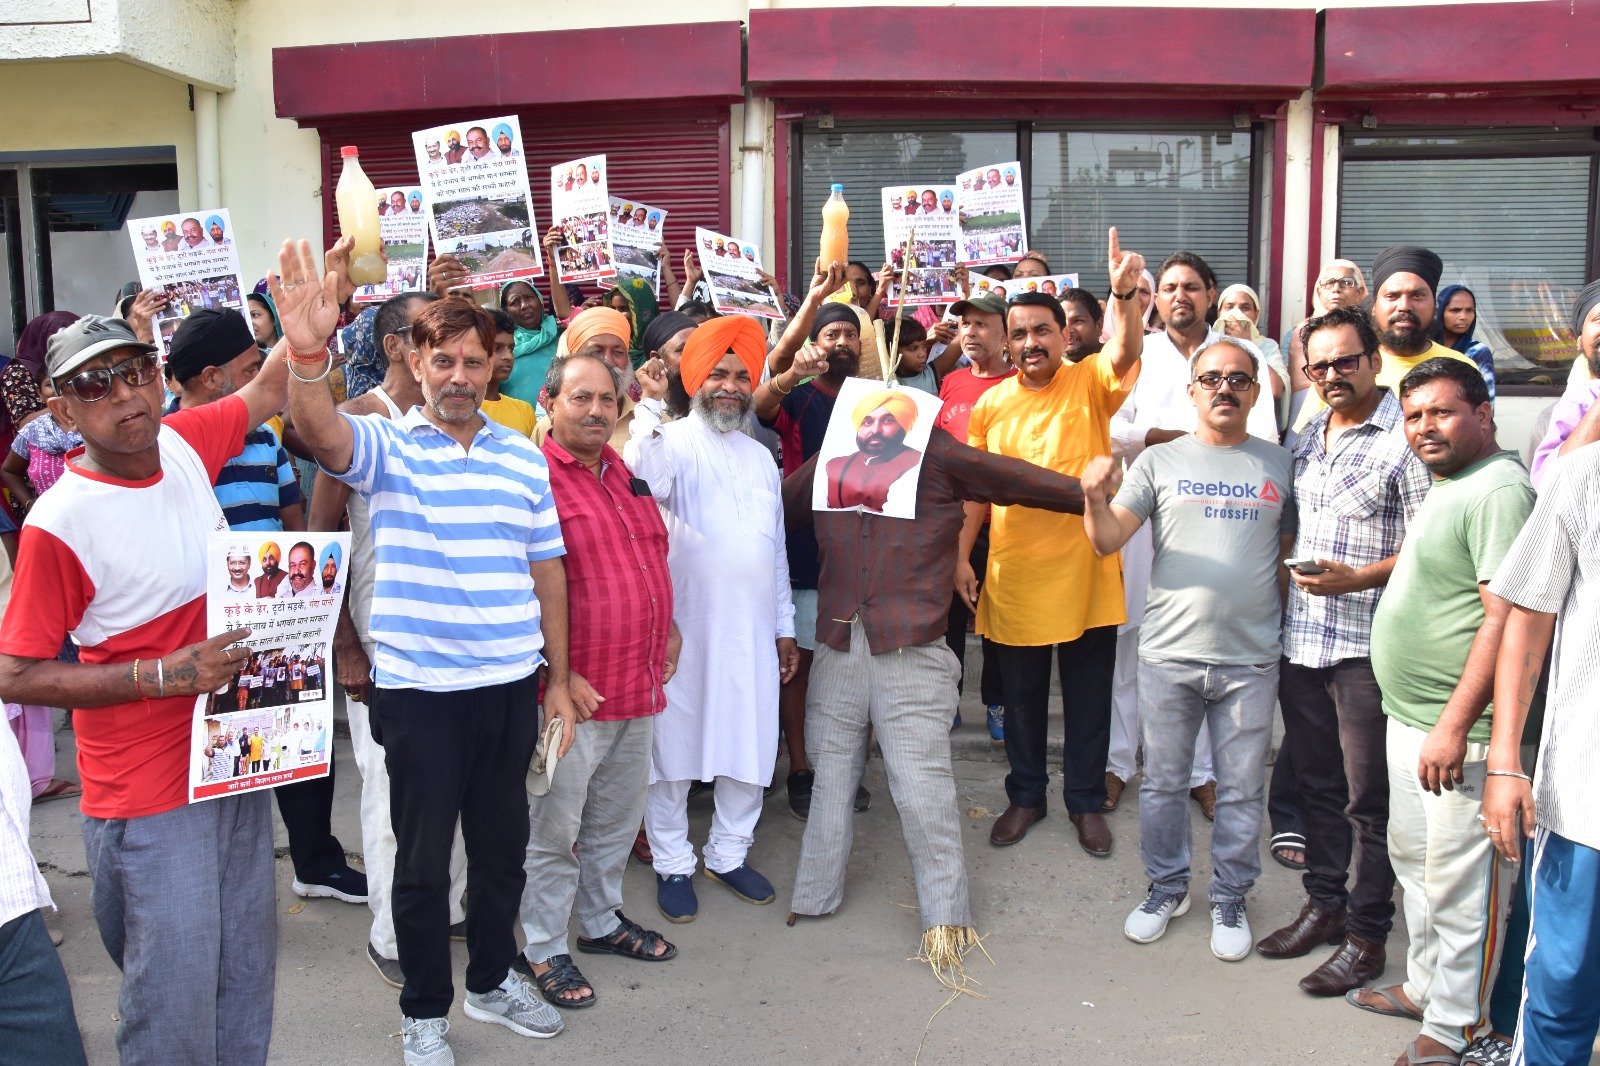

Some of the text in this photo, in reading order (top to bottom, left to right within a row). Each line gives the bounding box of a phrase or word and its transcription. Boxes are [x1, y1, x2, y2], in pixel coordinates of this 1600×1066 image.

[1177, 480, 1258, 498] Reebok
[1205, 506, 1259, 520] CrossFit
[224, 603, 241, 618] कूड़े
[244, 602, 253, 613] के
[272, 600, 285, 615] टूटी
[309, 599, 320, 608] गंदा
[322, 597, 334, 606] पानी
[245, 621, 266, 630] पंजाब
[277, 617, 296, 628] भगवंत
[310, 614, 329, 622] सरकार
[246, 639, 258, 648] एक
[259, 637, 273, 646] साल
[275, 633, 284, 642] की
[286, 630, 301, 641] सच्ची
[303, 628, 321, 639] कहानी
